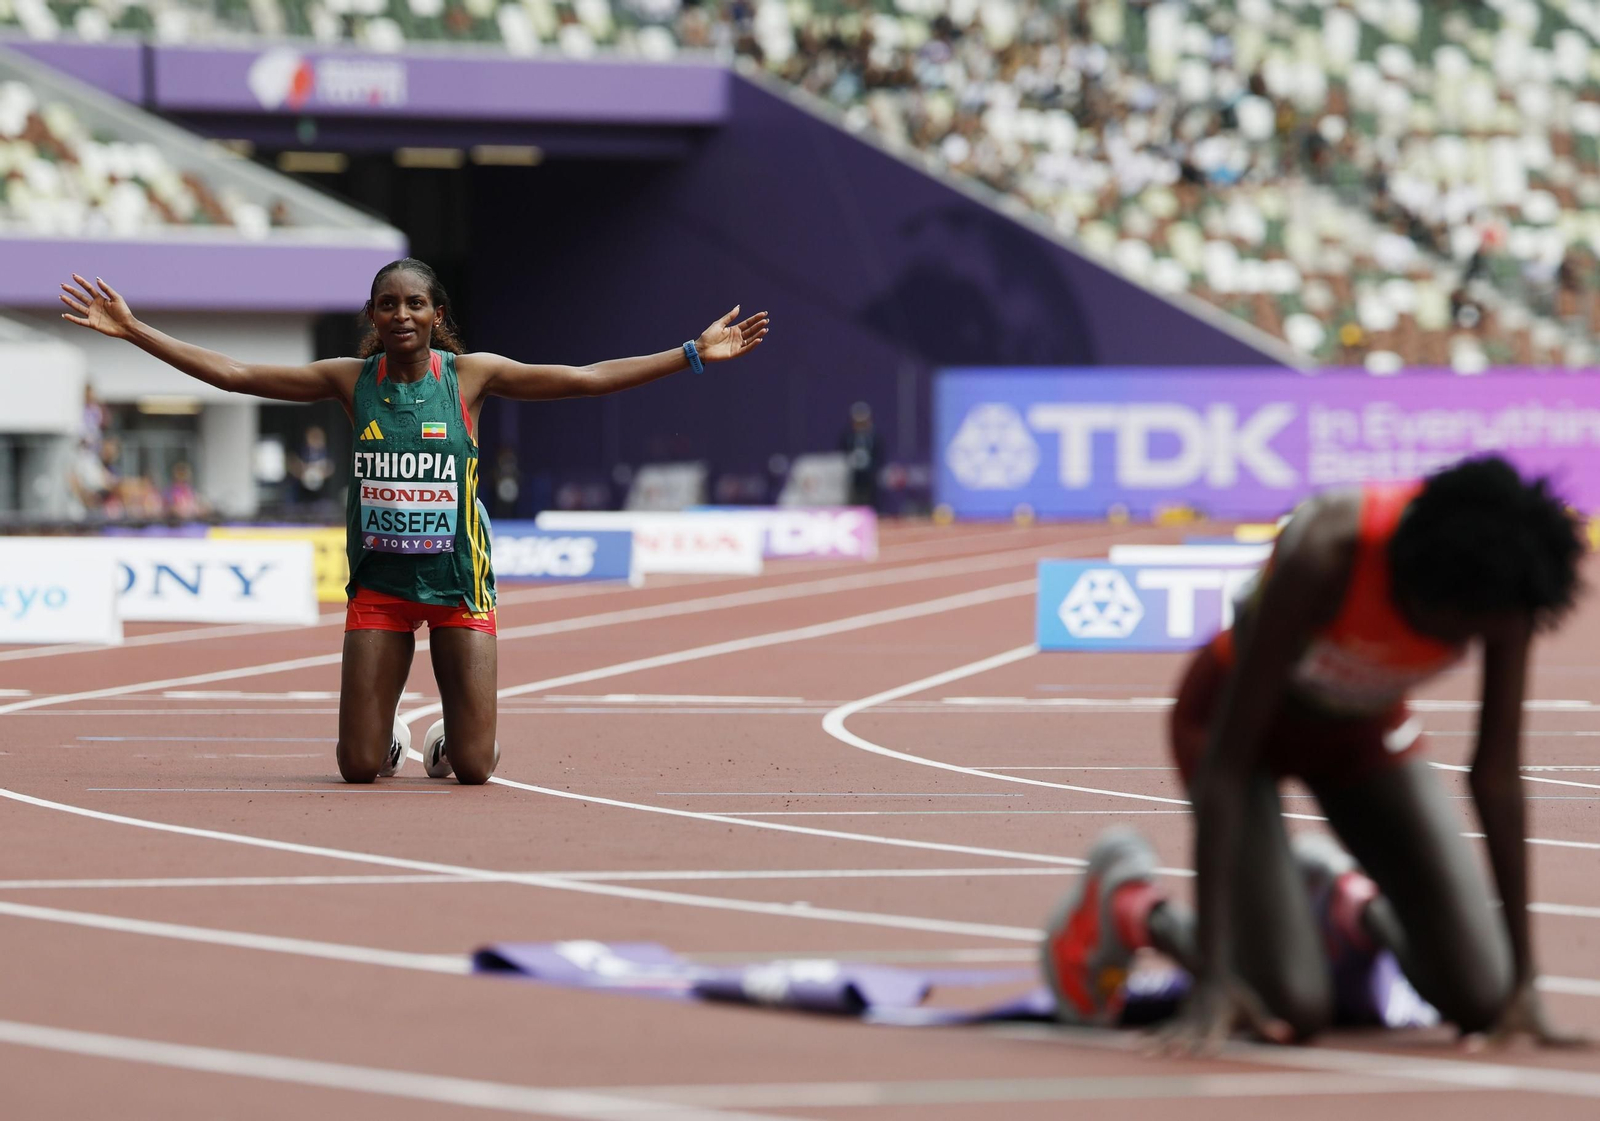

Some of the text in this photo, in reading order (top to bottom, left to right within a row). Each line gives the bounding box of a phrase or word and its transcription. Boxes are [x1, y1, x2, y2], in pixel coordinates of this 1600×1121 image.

[1029, 402, 1298, 489] TDK
[354, 452, 457, 481] ETHIOPIA
[362, 486, 456, 502] HONDA
[366, 509, 451, 533] ASSEFA
